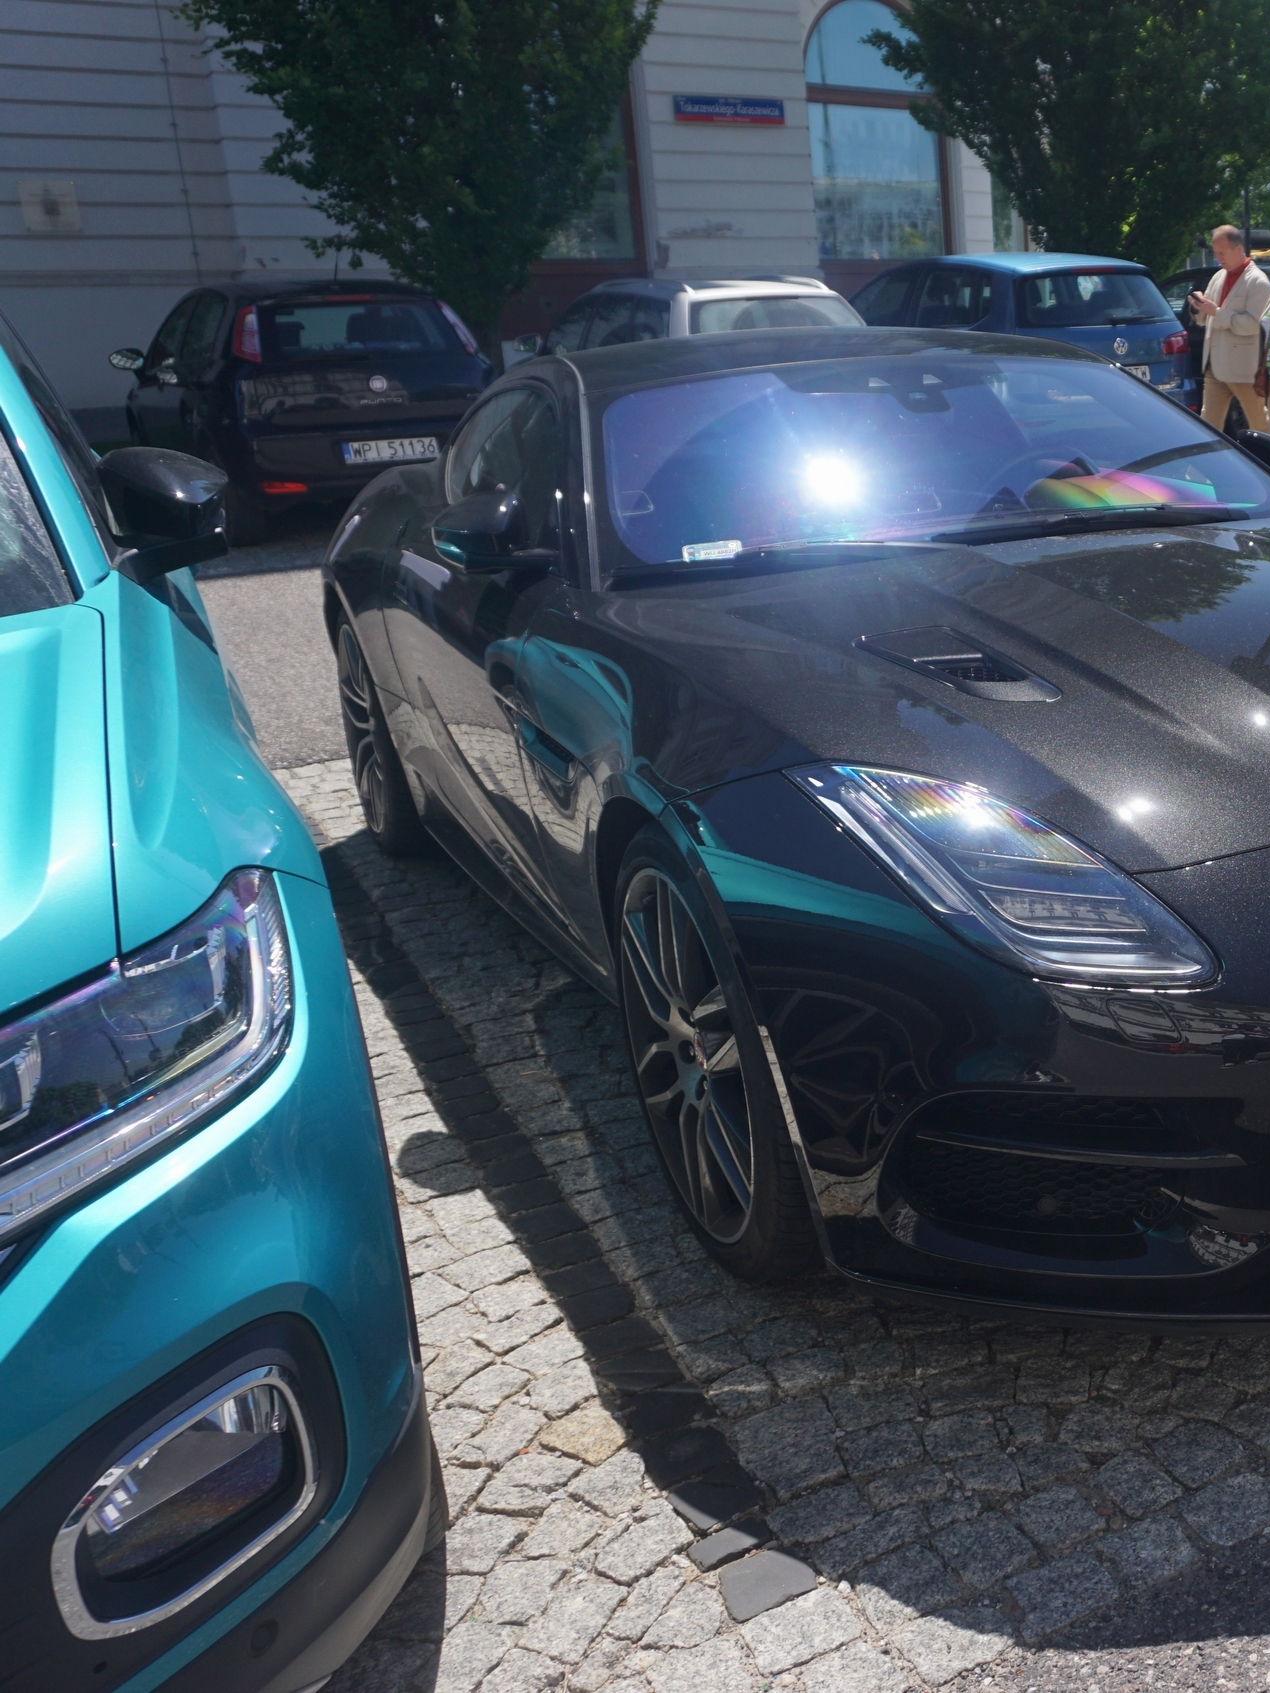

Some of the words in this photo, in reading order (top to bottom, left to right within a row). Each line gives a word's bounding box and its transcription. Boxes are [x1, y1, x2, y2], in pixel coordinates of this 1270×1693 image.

[680, 101, 779, 116] Tokarzewskiego-Karaszewicza
[1128, 367, 1148, 379] TW
[387, 438, 436, 456] 51136
